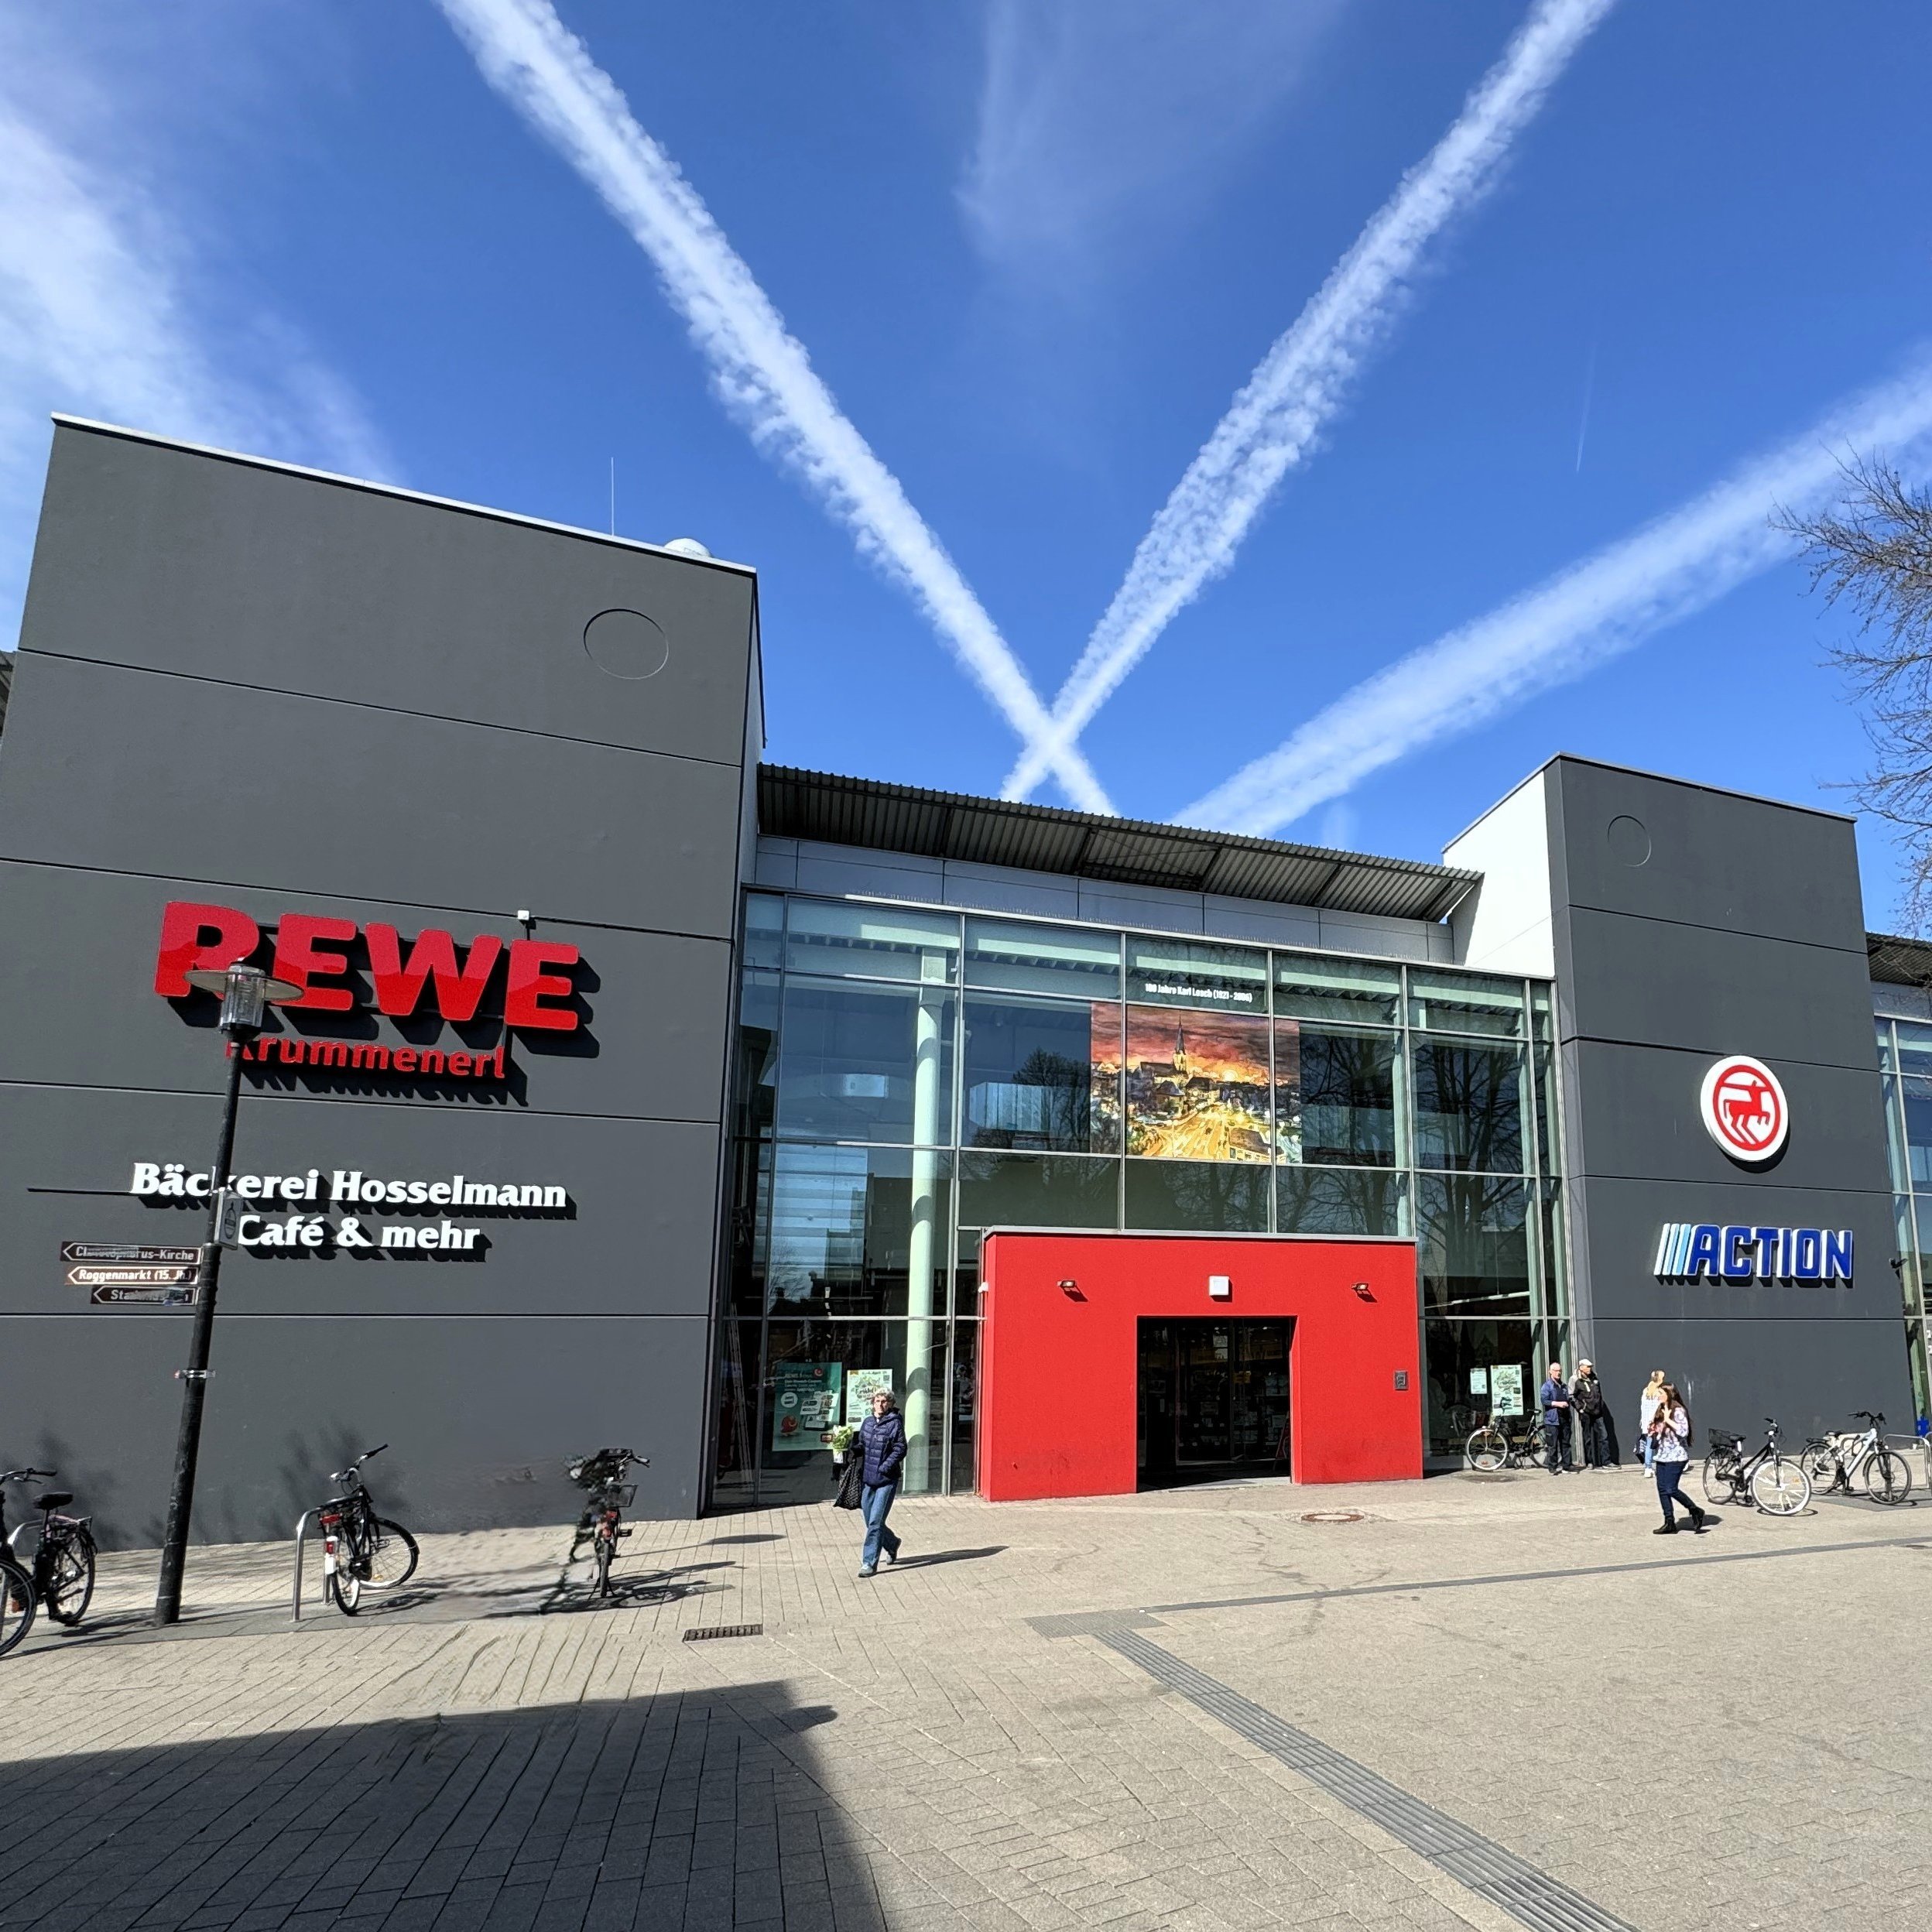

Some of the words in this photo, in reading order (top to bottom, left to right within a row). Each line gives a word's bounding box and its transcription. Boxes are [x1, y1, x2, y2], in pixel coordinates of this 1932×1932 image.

[154, 901, 579, 1030] REWE
[1157, 984, 1177, 995] Jahre
[331, 1170, 566, 1207] Hosselmann
[238, 1214, 324, 1246] Café
[336, 1217, 375, 1247] &
[380, 1220, 481, 1249] mehr
[76, 1246, 194, 1261] Crus-Kirche
[1684, 1224, 1853, 1279] ACTION
[79, 1269, 151, 1283] Roggenmarkt
[154, 1270, 170, 1280] (15.
